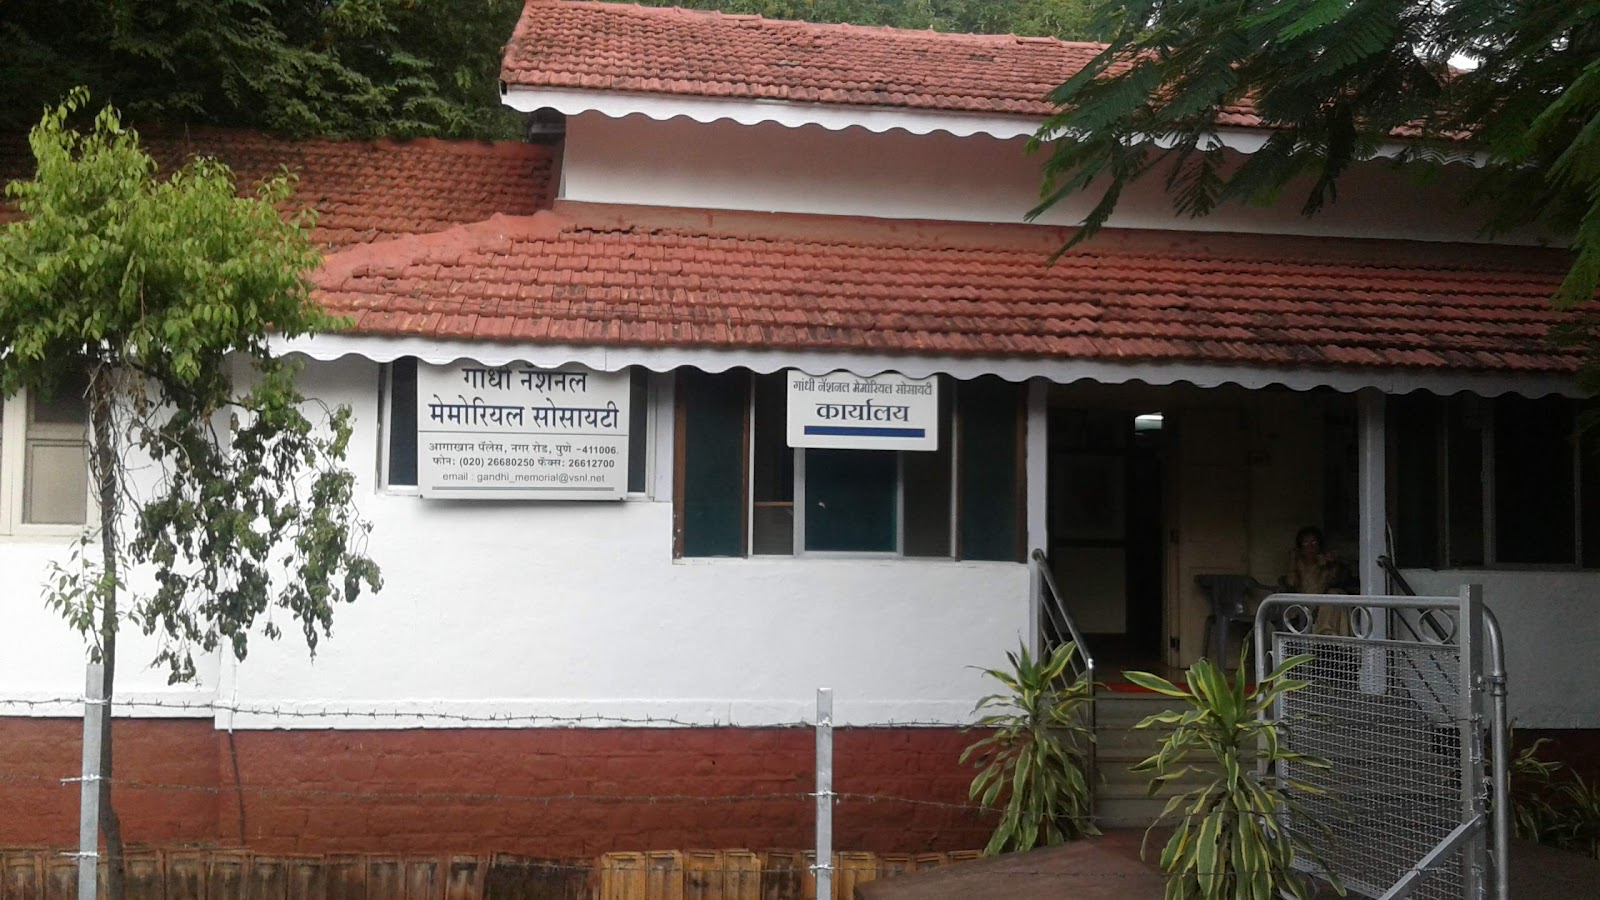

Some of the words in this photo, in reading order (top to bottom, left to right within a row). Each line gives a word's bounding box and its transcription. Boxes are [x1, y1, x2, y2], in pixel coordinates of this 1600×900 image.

[793, 377, 815, 392] गांधी
[852, 379, 893, 394] मेमोरियल
[895, 381, 933, 395] सोसायटी
[428, 394, 525, 427] मेमोरियल
[531, 398, 619, 429] सोसायटी
[815, 399, 910, 422] कार्यालय
[428, 442, 474, 452] आगाखान
[511, 443, 530, 453] नगर
[532, 441, 552, 455] रोड,
[555, 442, 572, 457] पुणे
[459, 457, 485, 468] (020)
[487, 457, 535, 467] 26680250
[568, 459, 615, 468] 26612700
[442, 472, 468, 481] email
[476, 472, 605, 484] gandhi_memorial@vsnl.net
